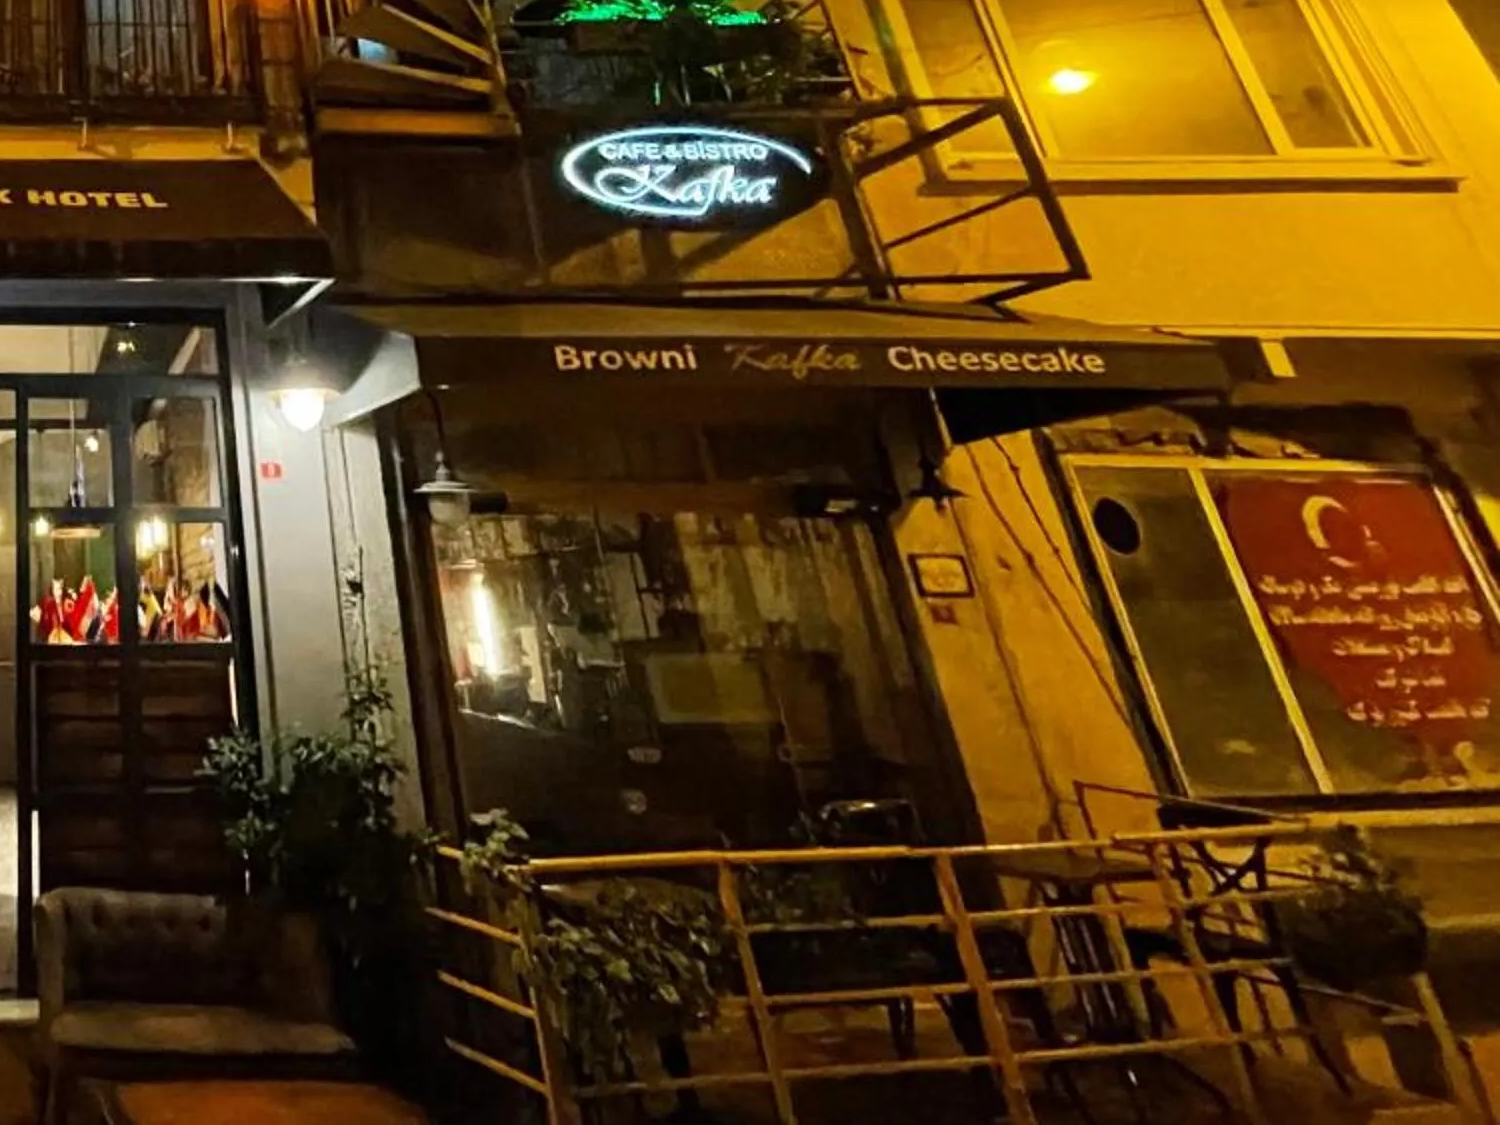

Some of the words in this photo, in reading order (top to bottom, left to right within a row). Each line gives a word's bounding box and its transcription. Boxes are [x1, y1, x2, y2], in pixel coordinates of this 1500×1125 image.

[598, 142, 661, 160] CAFE
[662, 144, 681, 159] &
[27, 190, 169, 208] HOTEL
[594, 164, 778, 216] Kafka
[554, 344, 697, 371] Browni
[724, 344, 862, 380] Kafka
[887, 346, 1106, 373] Cheesecake
